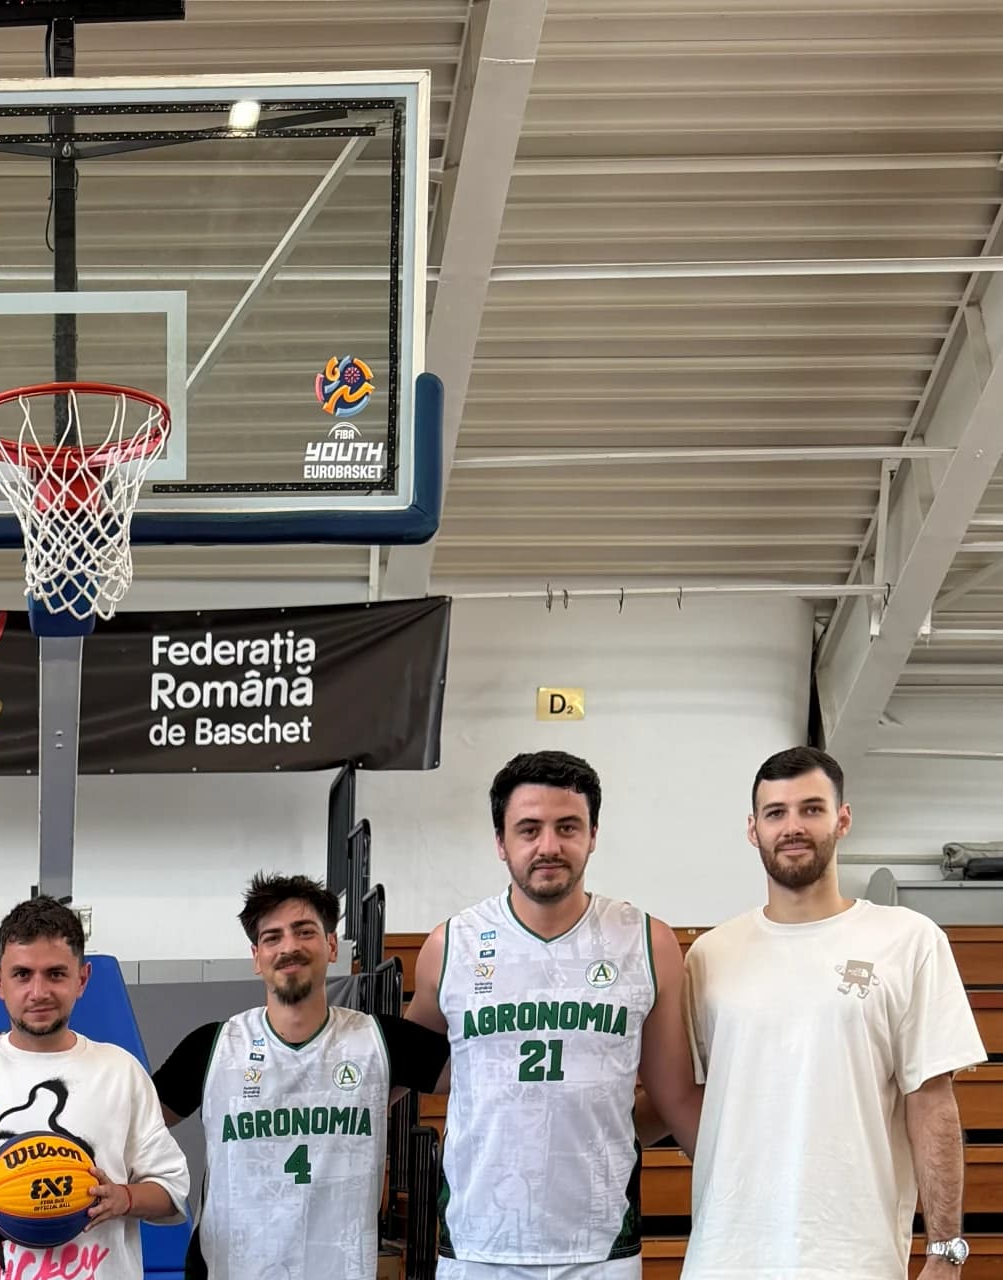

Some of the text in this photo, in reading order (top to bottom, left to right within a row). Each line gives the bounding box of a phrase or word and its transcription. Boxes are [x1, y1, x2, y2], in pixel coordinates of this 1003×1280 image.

[304, 442, 384, 462] YOUTH
[334, 429, 355, 440] FIBA
[303, 464, 384, 479] EUROBASKET
[152, 630, 316, 673] Federația
[150, 665, 314, 711] Română
[149, 714, 313, 746] de Baschet
[463, 1001, 628, 1040] AGRONOMIA
[518, 1039, 565, 1082] 21
[222, 1106, 372, 1143] AGRONOMIA
[3, 1142, 83, 1169] Wilson
[284, 1144, 312, 1185] 4
